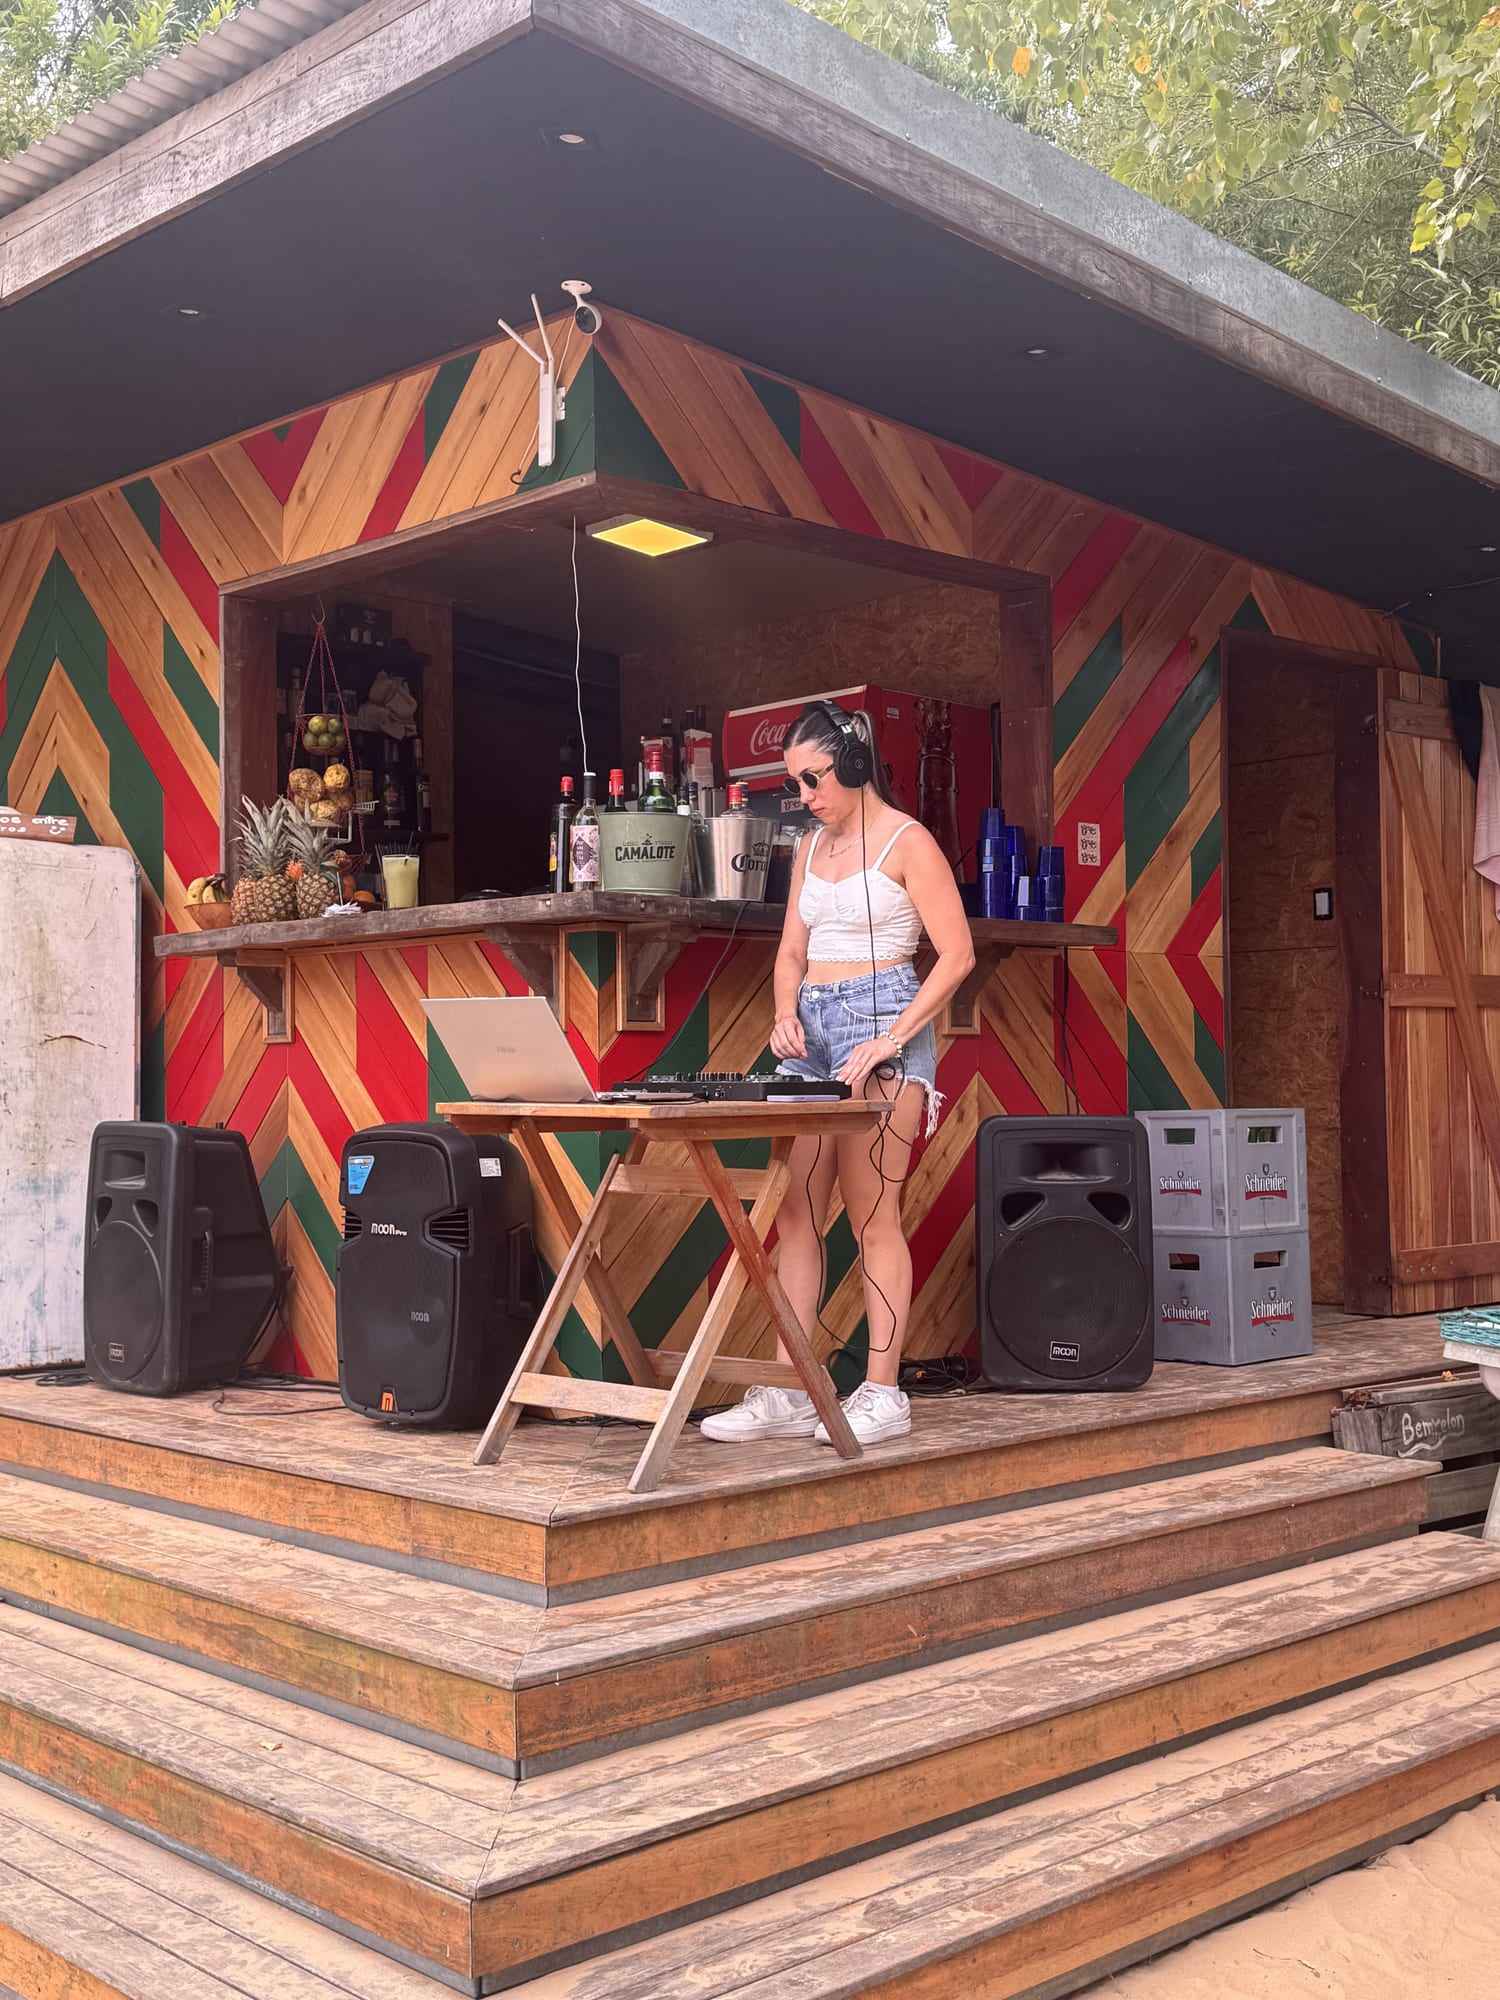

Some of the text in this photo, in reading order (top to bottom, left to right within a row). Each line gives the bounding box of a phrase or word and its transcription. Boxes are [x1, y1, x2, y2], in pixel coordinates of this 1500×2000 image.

[32, 816, 69, 826] entre
[615, 845, 676, 862] CAMALOTE
[1160, 1177, 1200, 1190] Schneider
[1245, 1173, 1287, 1192] Schneider
[1161, 1303, 1209, 1321] Schneider
[1251, 1298, 1293, 1320] Schneider
